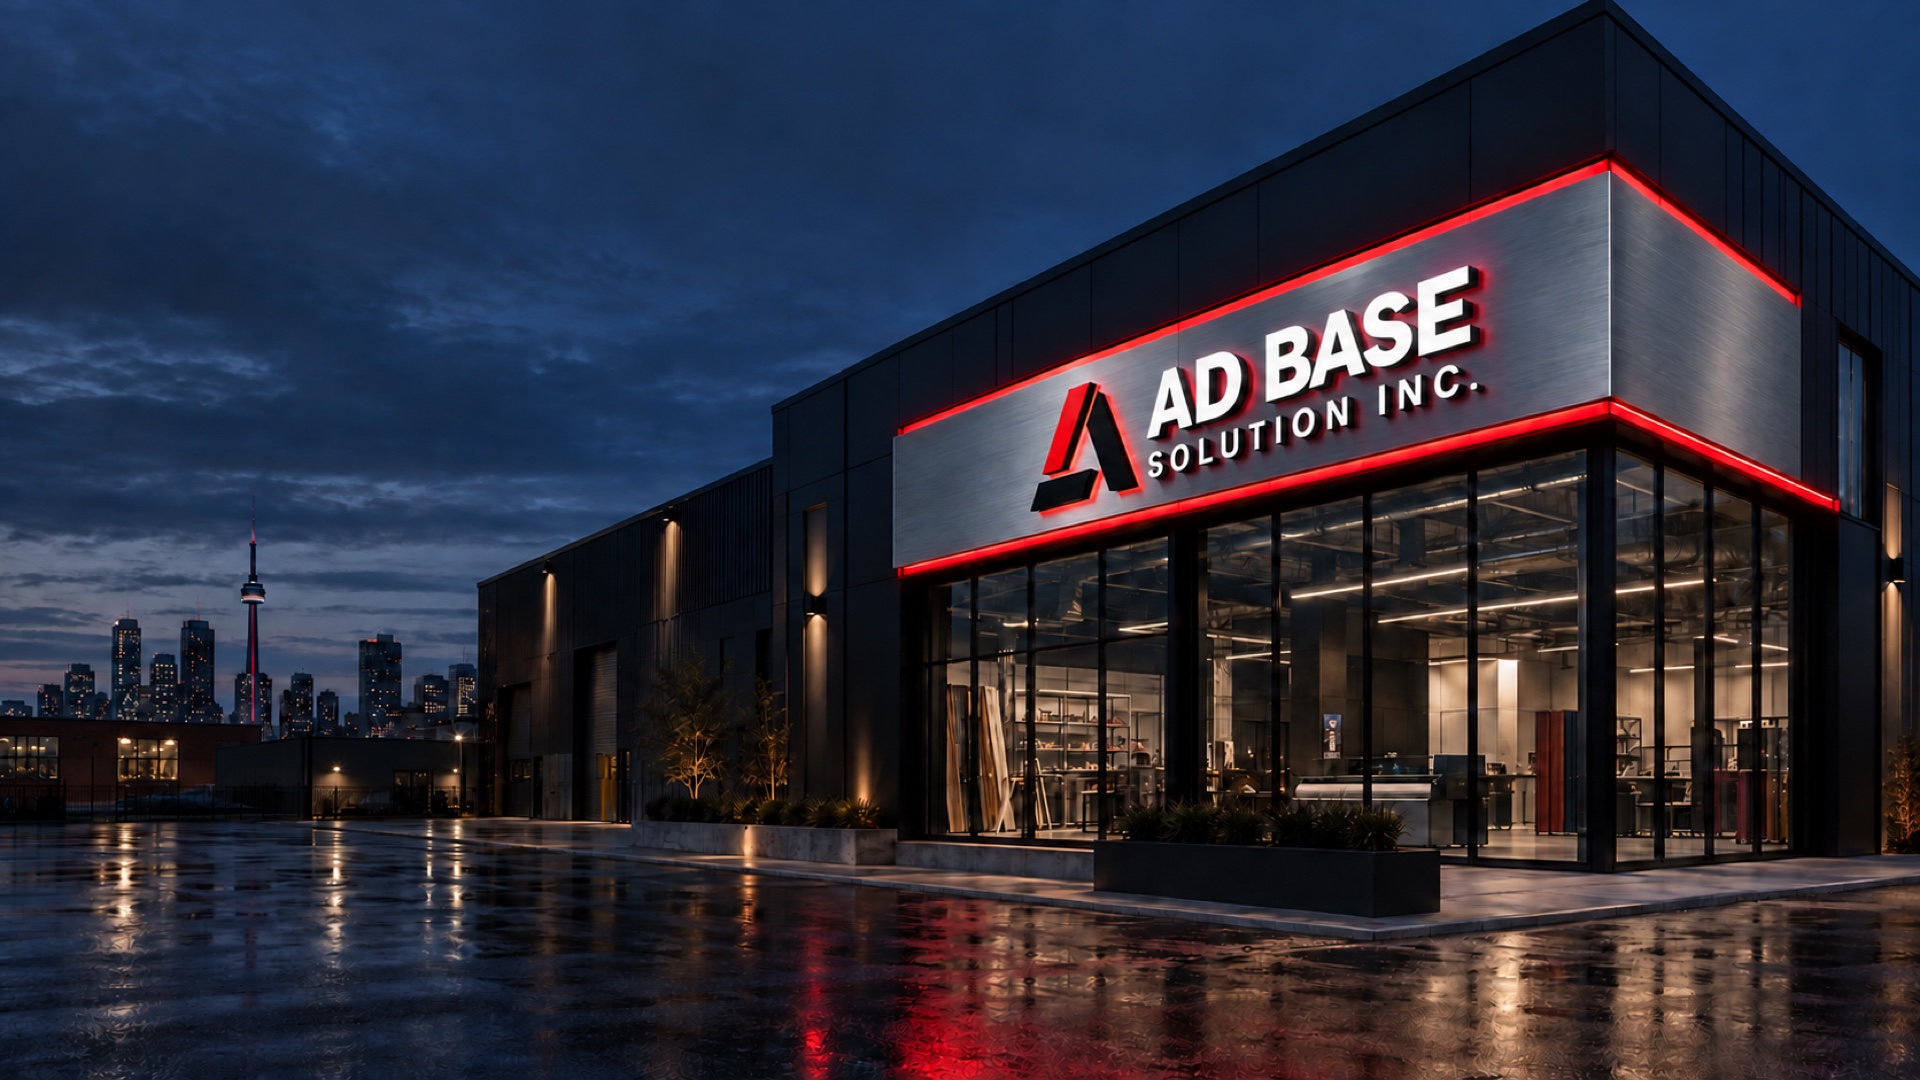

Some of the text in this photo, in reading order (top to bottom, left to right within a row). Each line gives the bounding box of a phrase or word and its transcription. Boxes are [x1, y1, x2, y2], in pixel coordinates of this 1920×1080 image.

[1146, 265, 1472, 440] AD BASE
[1147, 364, 1478, 478] SOLUTION INC.
